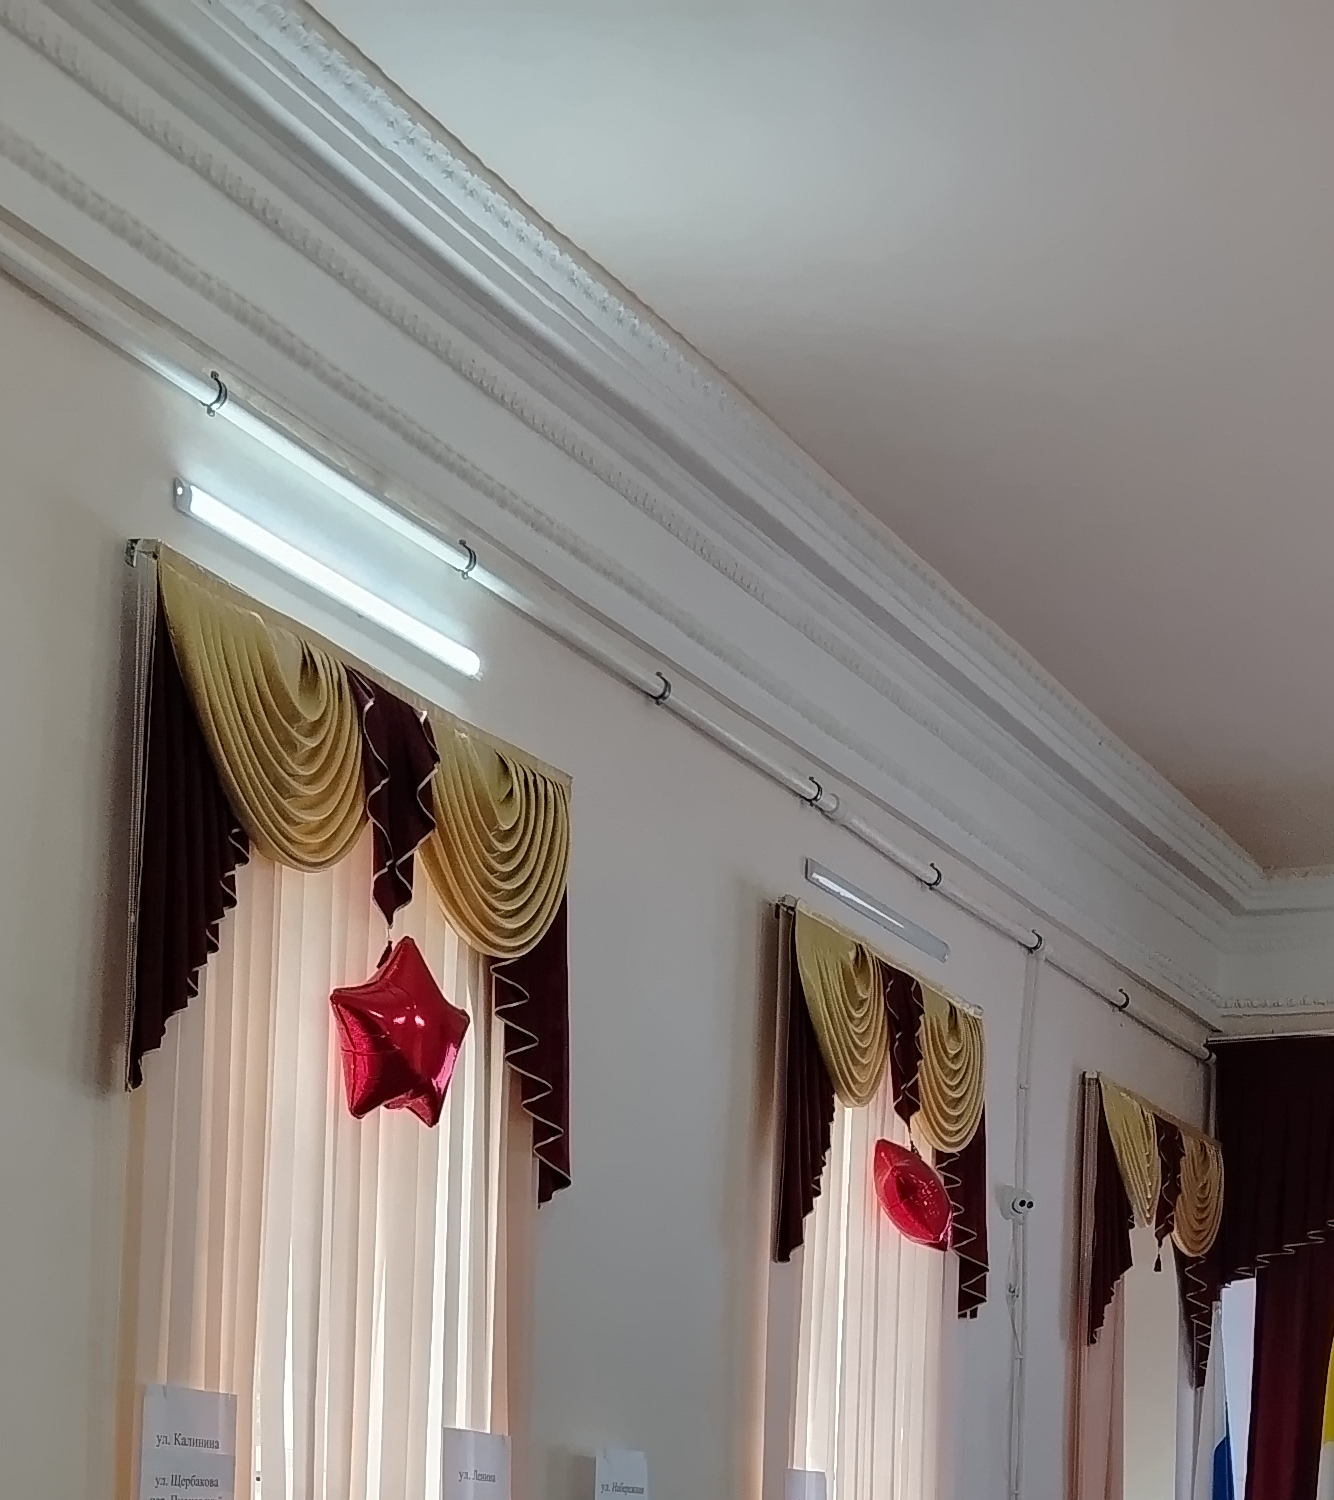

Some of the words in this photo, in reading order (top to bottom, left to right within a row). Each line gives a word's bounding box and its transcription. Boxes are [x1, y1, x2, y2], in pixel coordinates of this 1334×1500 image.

[156, 1434, 170, 1447] ул.
[174, 1433, 219, 1449] Калинина
[155, 1477, 168, 1488] ул.
[171, 1475, 219, 1489] Щербакова
[459, 1471, 470, 1482] ул.
